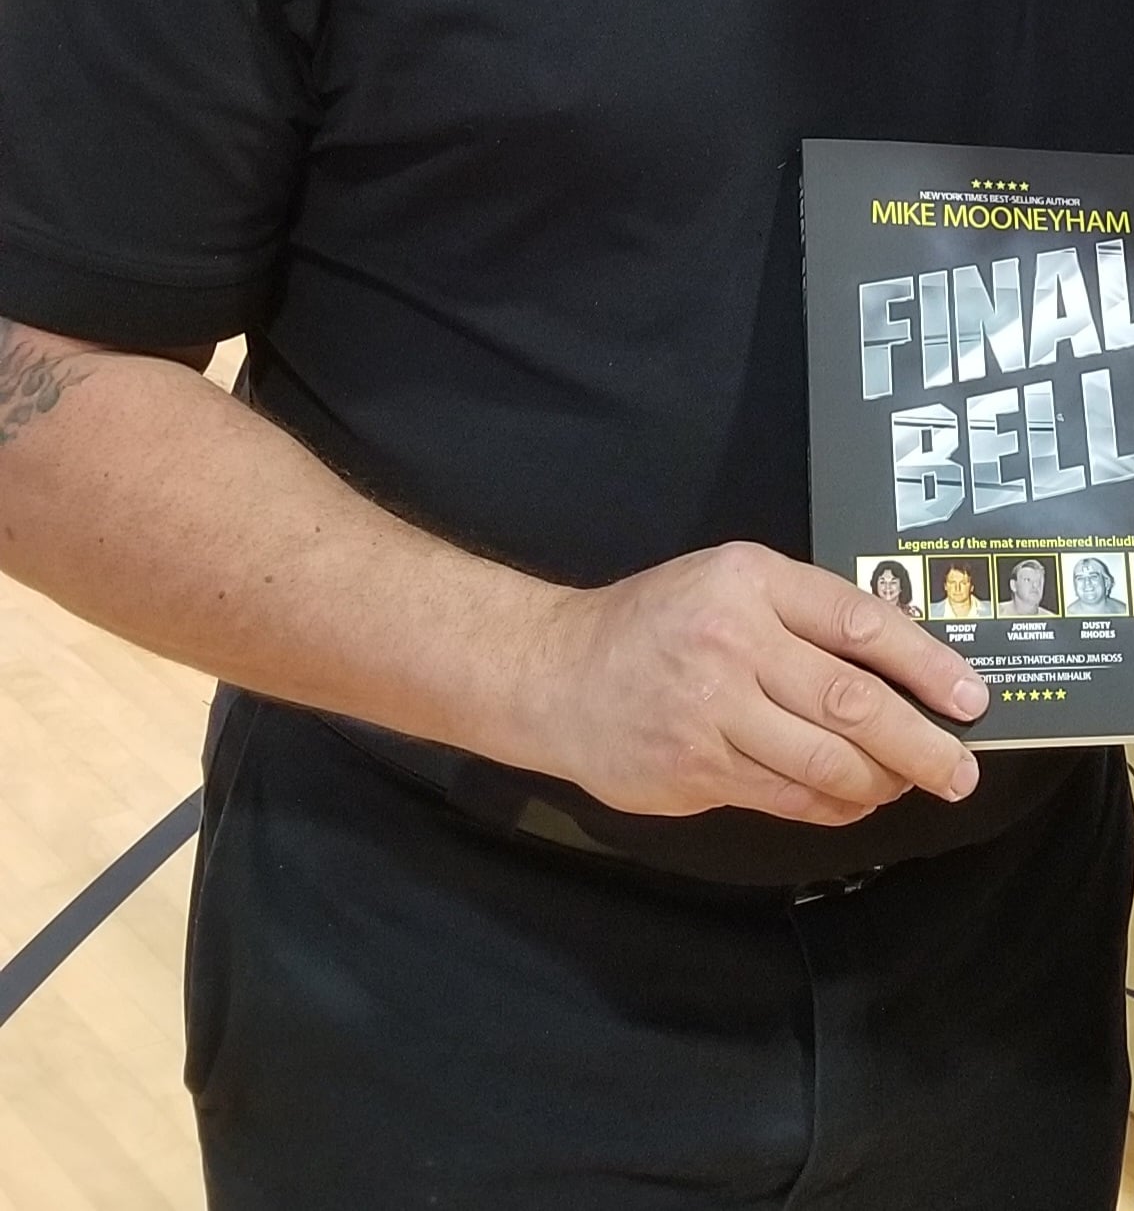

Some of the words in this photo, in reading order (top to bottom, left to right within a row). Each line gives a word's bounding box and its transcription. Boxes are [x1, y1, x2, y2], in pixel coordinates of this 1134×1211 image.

[919, 191, 940, 201] NEW
[940, 192, 964, 202] YORK
[964, 193, 988, 203] TIMES
[989, 194, 1044, 205] BEST-SELLING
[1045, 197, 1080, 206] AUTHOR
[872, 200, 936, 227] MIKE
[943, 204, 1131, 234] MOONEYHAM
[898, 538, 949, 552] Legends
[951, 537, 965, 549] of
[966, 537, 987, 549] the
[989, 538, 1013, 549] mat
[1015, 536, 1093, 548] remembered
[946, 624, 977, 632] RODDY
[1012, 622, 1047, 631] JOHNNY
[1082, 621, 1111, 630] DUSTY
[949, 633, 975, 642] PIPER
[1007, 631, 1055, 640] VALENTINE
[1081, 630, 1115, 639] RHODES
[965, 657, 994, 666] ORDS
[996, 656, 1006, 665] BY
[1008, 656, 1022, 665] LES
[1023, 654, 1065, 665] THATCHER
[1066, 654, 1085, 663] AND
[1086, 654, 1100, 663] JIM
[1101, 653, 1123, 662] ROSS
[980, 674, 1004, 684] DITED
[1005, 673, 1016, 683] BY
[1017, 672, 1057, 683] KENNETH
[1057, 671, 1092, 681] MIHALIK
